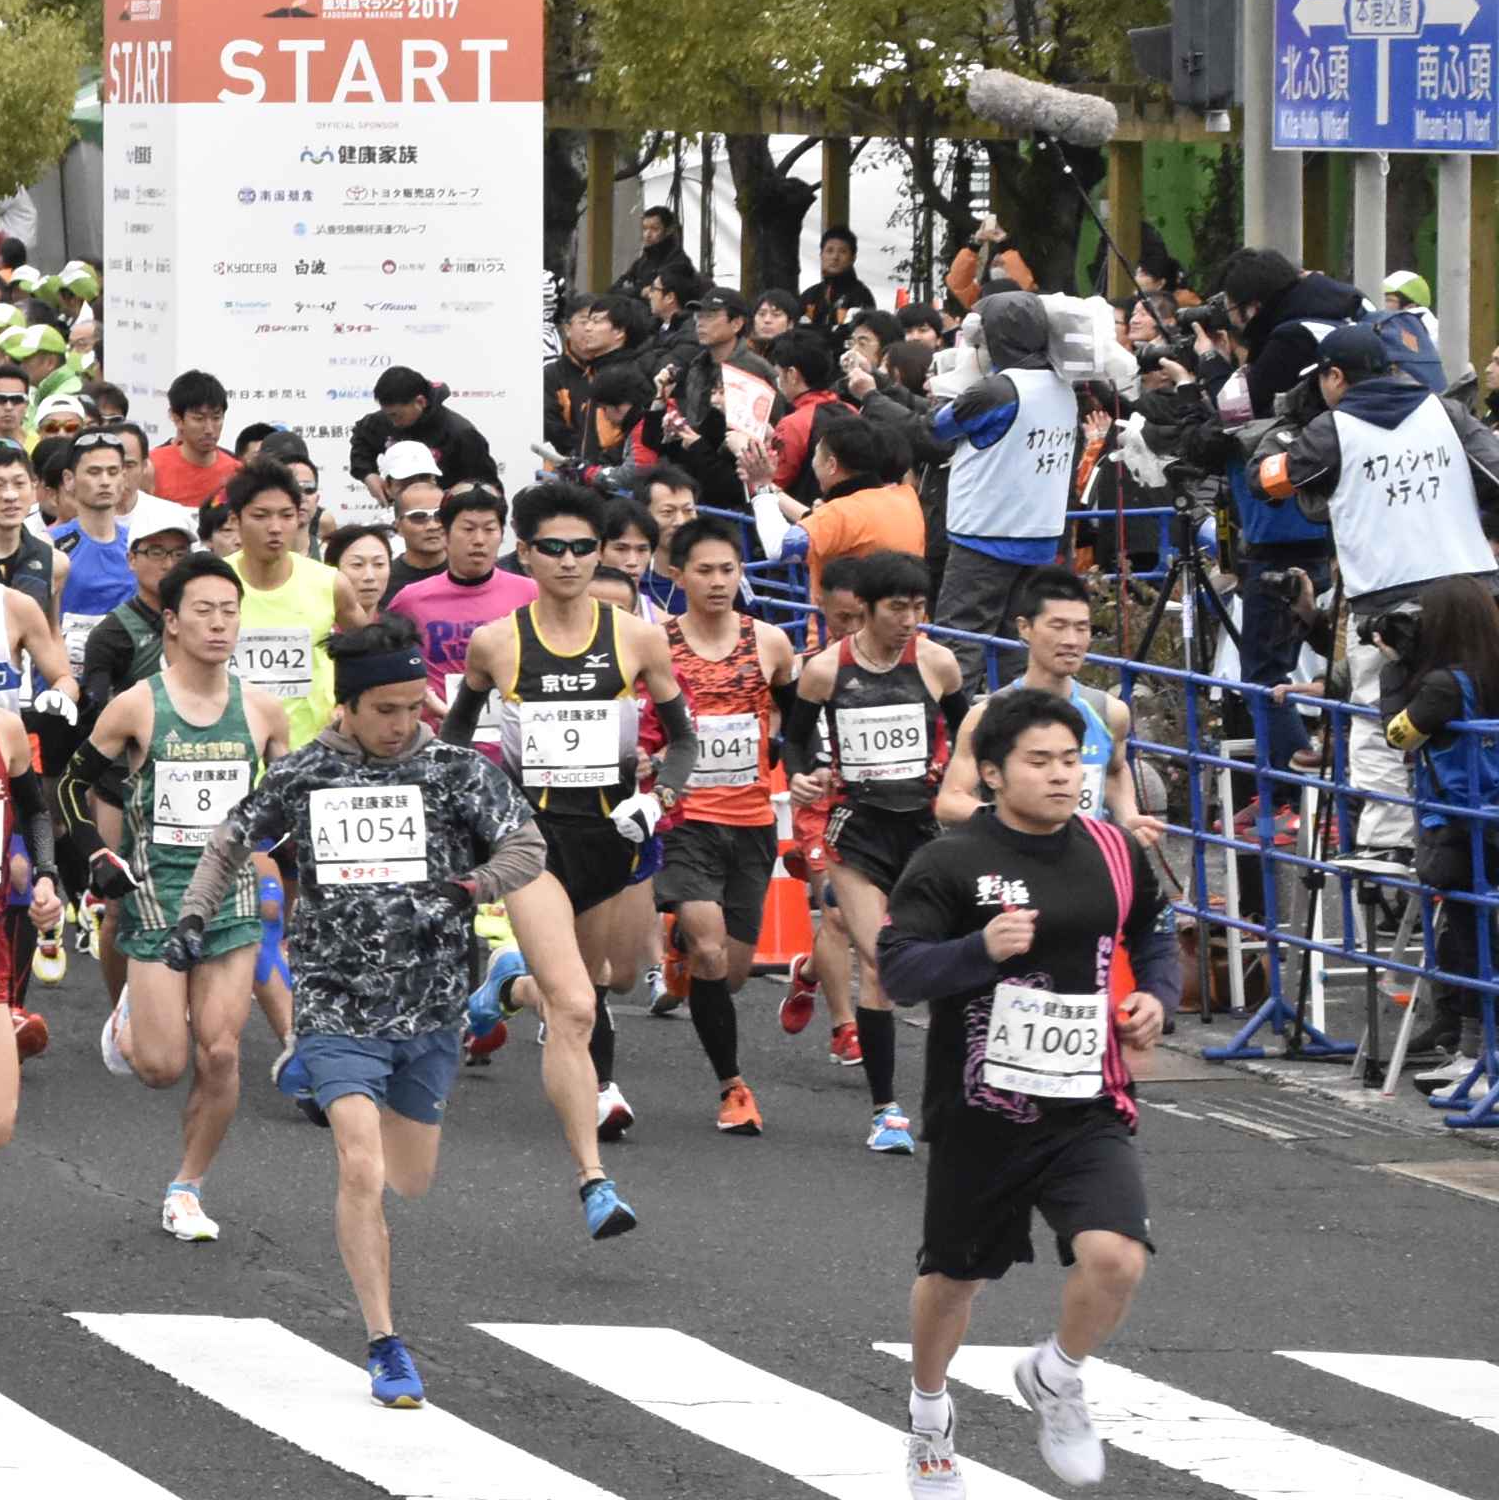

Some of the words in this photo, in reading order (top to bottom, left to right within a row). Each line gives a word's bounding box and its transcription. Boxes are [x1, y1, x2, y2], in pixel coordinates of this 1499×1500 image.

[109, 41, 171, 103] START
[217, 39, 508, 103] START
[1281, 45, 1350, 101] 北ふ頭
[1416, 44, 1492, 101] 南ふ頭
[338, 145, 418, 165] 健康家族
[370, 188, 480, 199] トヨタ販売店グループ
[294, 259, 328, 275] 白波
[1035, 452, 1069, 474] メディア
[1363, 446, 1450, 482] オフィシャル
[1386, 476, 1440, 507] メディア
[229, 654, 239, 670] A
[245, 647, 306, 669] 1042
[541, 673, 597, 692] 京セラ
[557, 708, 607, 723] 健康家族
[526, 736, 538, 753] A
[563, 728, 580, 752] 9
[698, 736, 752, 759] 1041
[842, 736, 854, 751] A
[859, 727, 921, 752] 1089
[193, 768, 238, 782] 健康家族
[160, 794, 171, 810] A
[197, 788, 211, 812] 8
[351, 796, 409, 810] 健康家族
[1079, 789, 1093, 810] 8
[317, 827, 330, 846] A
[337, 816, 417, 844] 1054
[353, 867, 400, 878] タイヨー
[1044, 1002, 1098, 1019] 健康家族
[994, 1025, 1009, 1046] A
[1023, 1023, 1098, 1056] 1003
